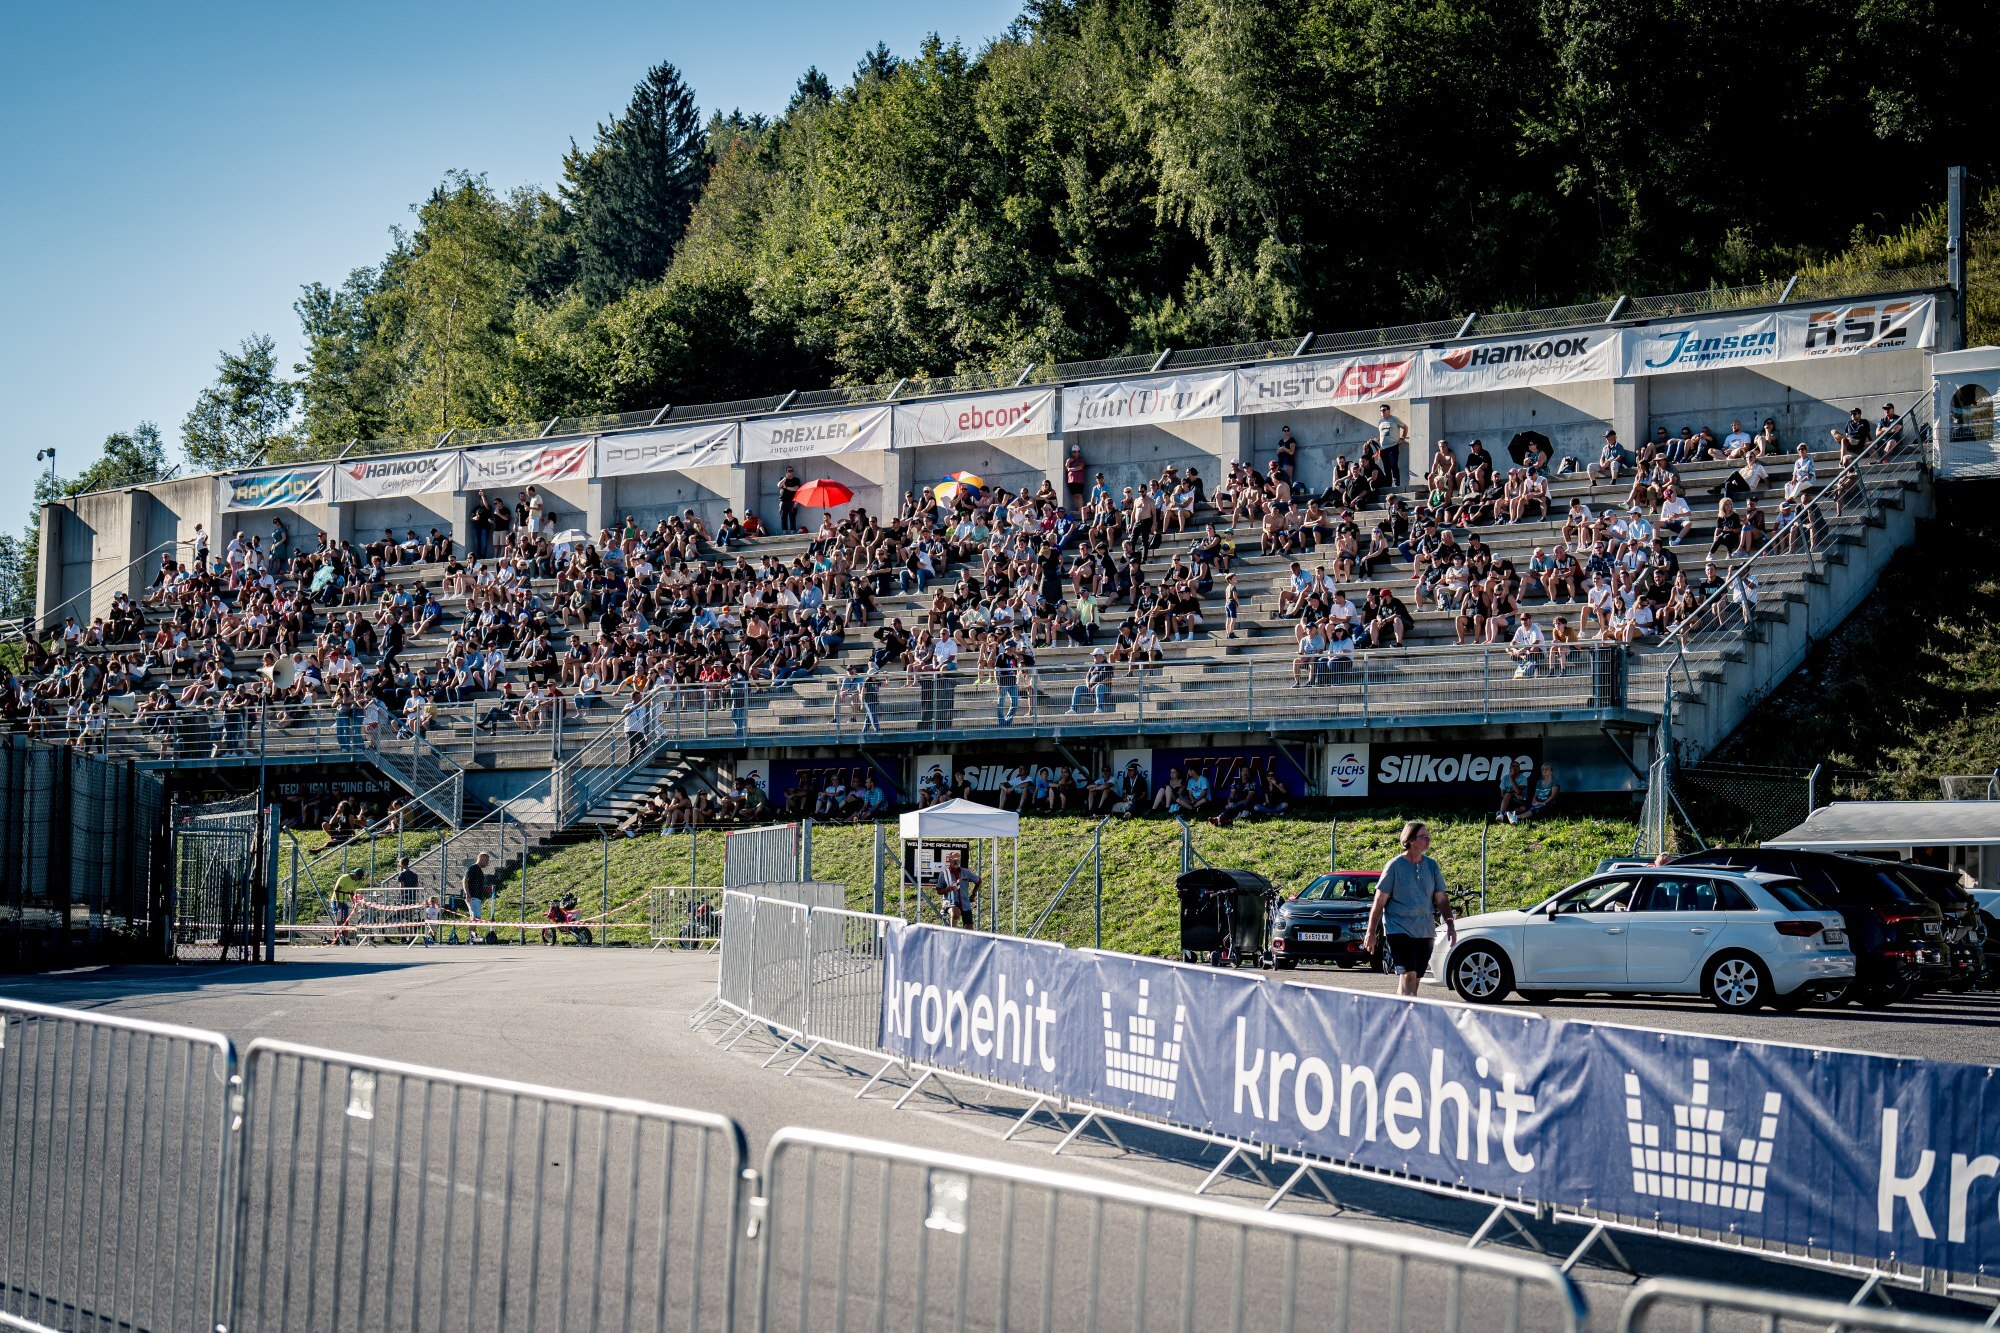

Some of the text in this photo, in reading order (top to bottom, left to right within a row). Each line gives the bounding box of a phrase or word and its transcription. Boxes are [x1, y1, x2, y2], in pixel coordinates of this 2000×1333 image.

[1645, 331, 1776, 368] Jansen
[1679, 347, 1773, 362] COMPETITION
[1258, 369, 1400, 398] HISTO CUP
[958, 401, 1031, 430] ebcont
[769, 444, 815, 454] AUTOMOTIVE
[478, 459, 532, 477] HISTO
[1331, 765, 1366, 776] FUCHS
[887, 953, 1057, 1073] kronehit
[1233, 1015, 1536, 1174] kronehit
